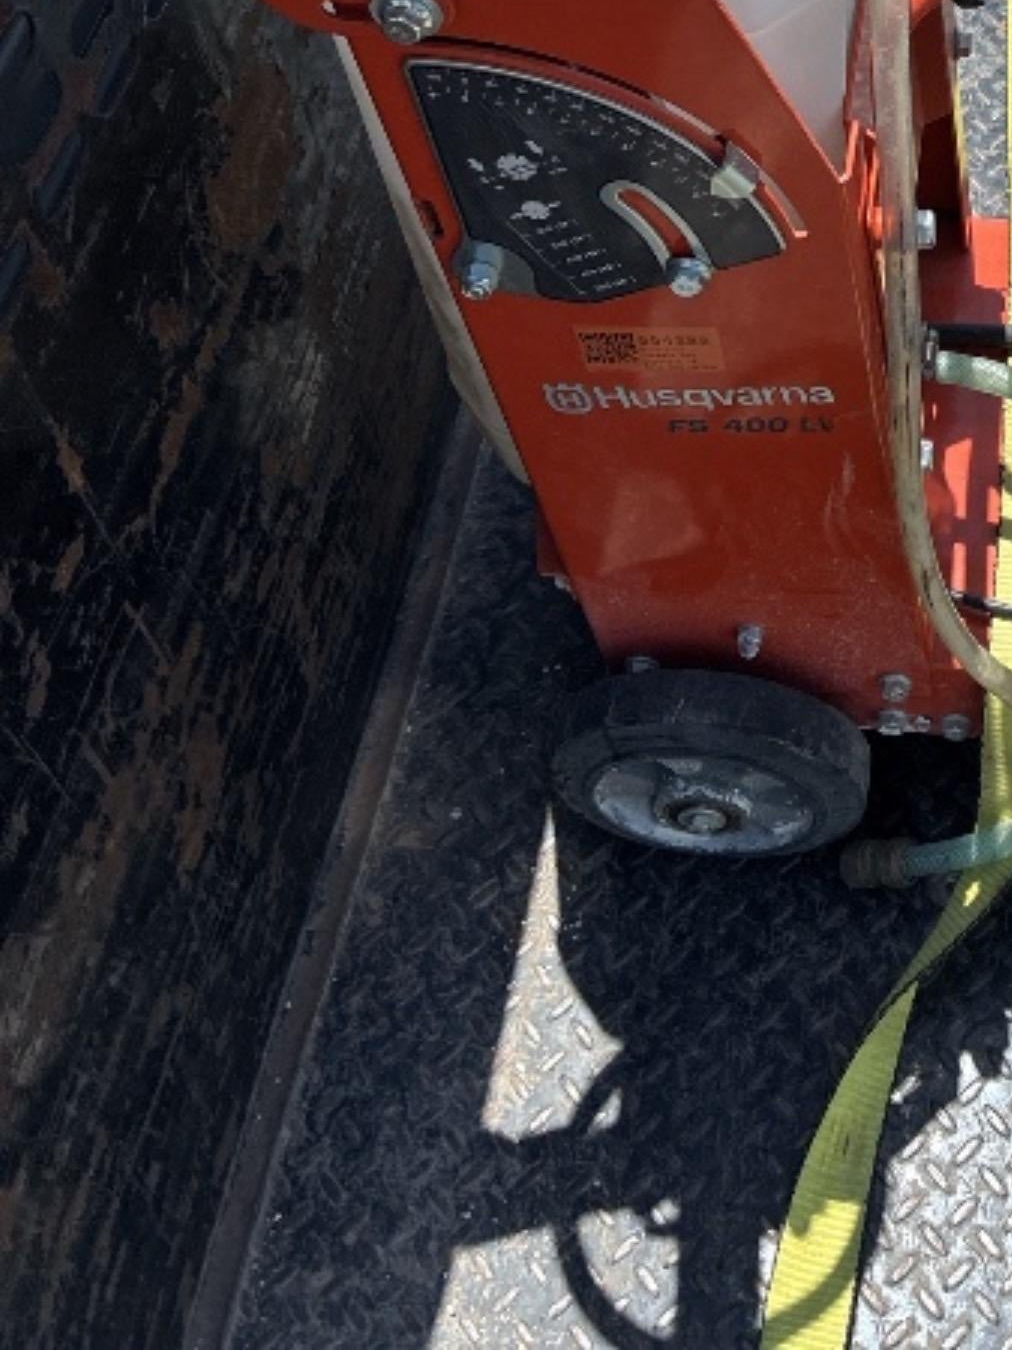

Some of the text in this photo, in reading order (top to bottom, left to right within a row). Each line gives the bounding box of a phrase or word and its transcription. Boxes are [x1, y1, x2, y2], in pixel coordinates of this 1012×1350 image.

[593, 384, 835, 412] Husqvarna
[667, 418, 708, 433] FS
[722, 417, 788, 433] 400
